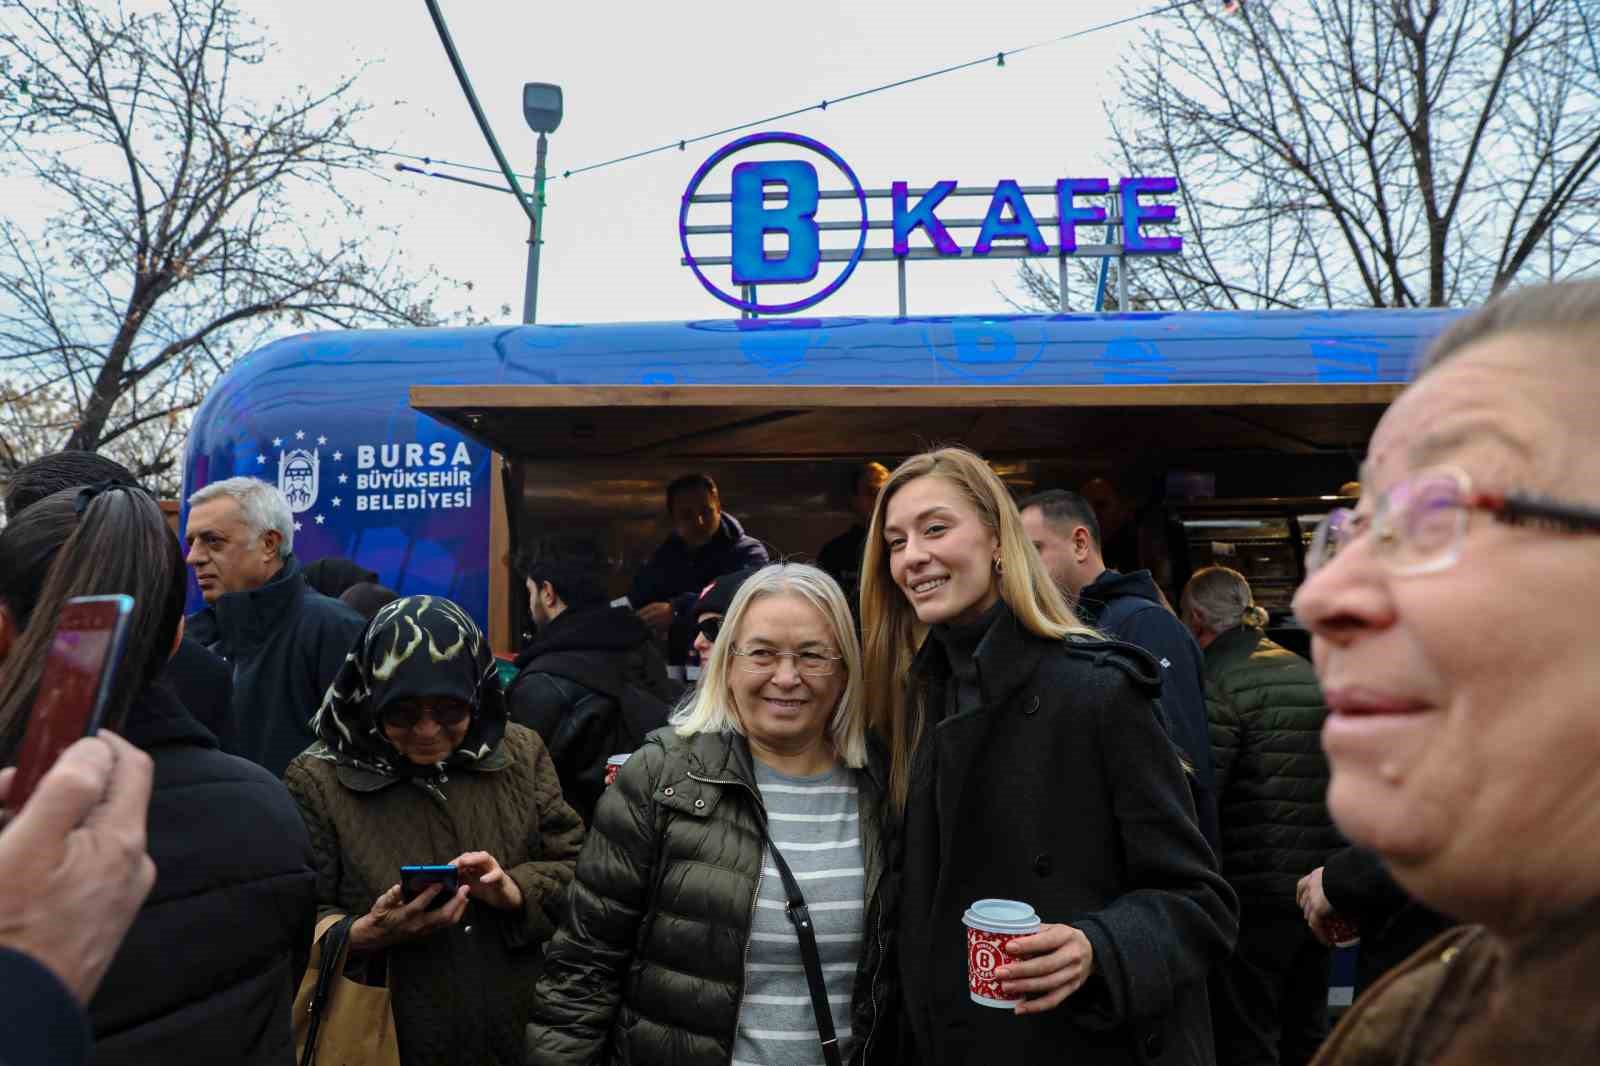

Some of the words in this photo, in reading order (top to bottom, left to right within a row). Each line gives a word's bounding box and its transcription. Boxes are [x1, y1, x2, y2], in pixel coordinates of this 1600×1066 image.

[731, 160, 820, 285] B
[892, 177, 1183, 255] KAFE
[357, 441, 472, 469] BURSA
[356, 487, 472, 511] BELEDİYESİ
[980, 952, 989, 968] B
